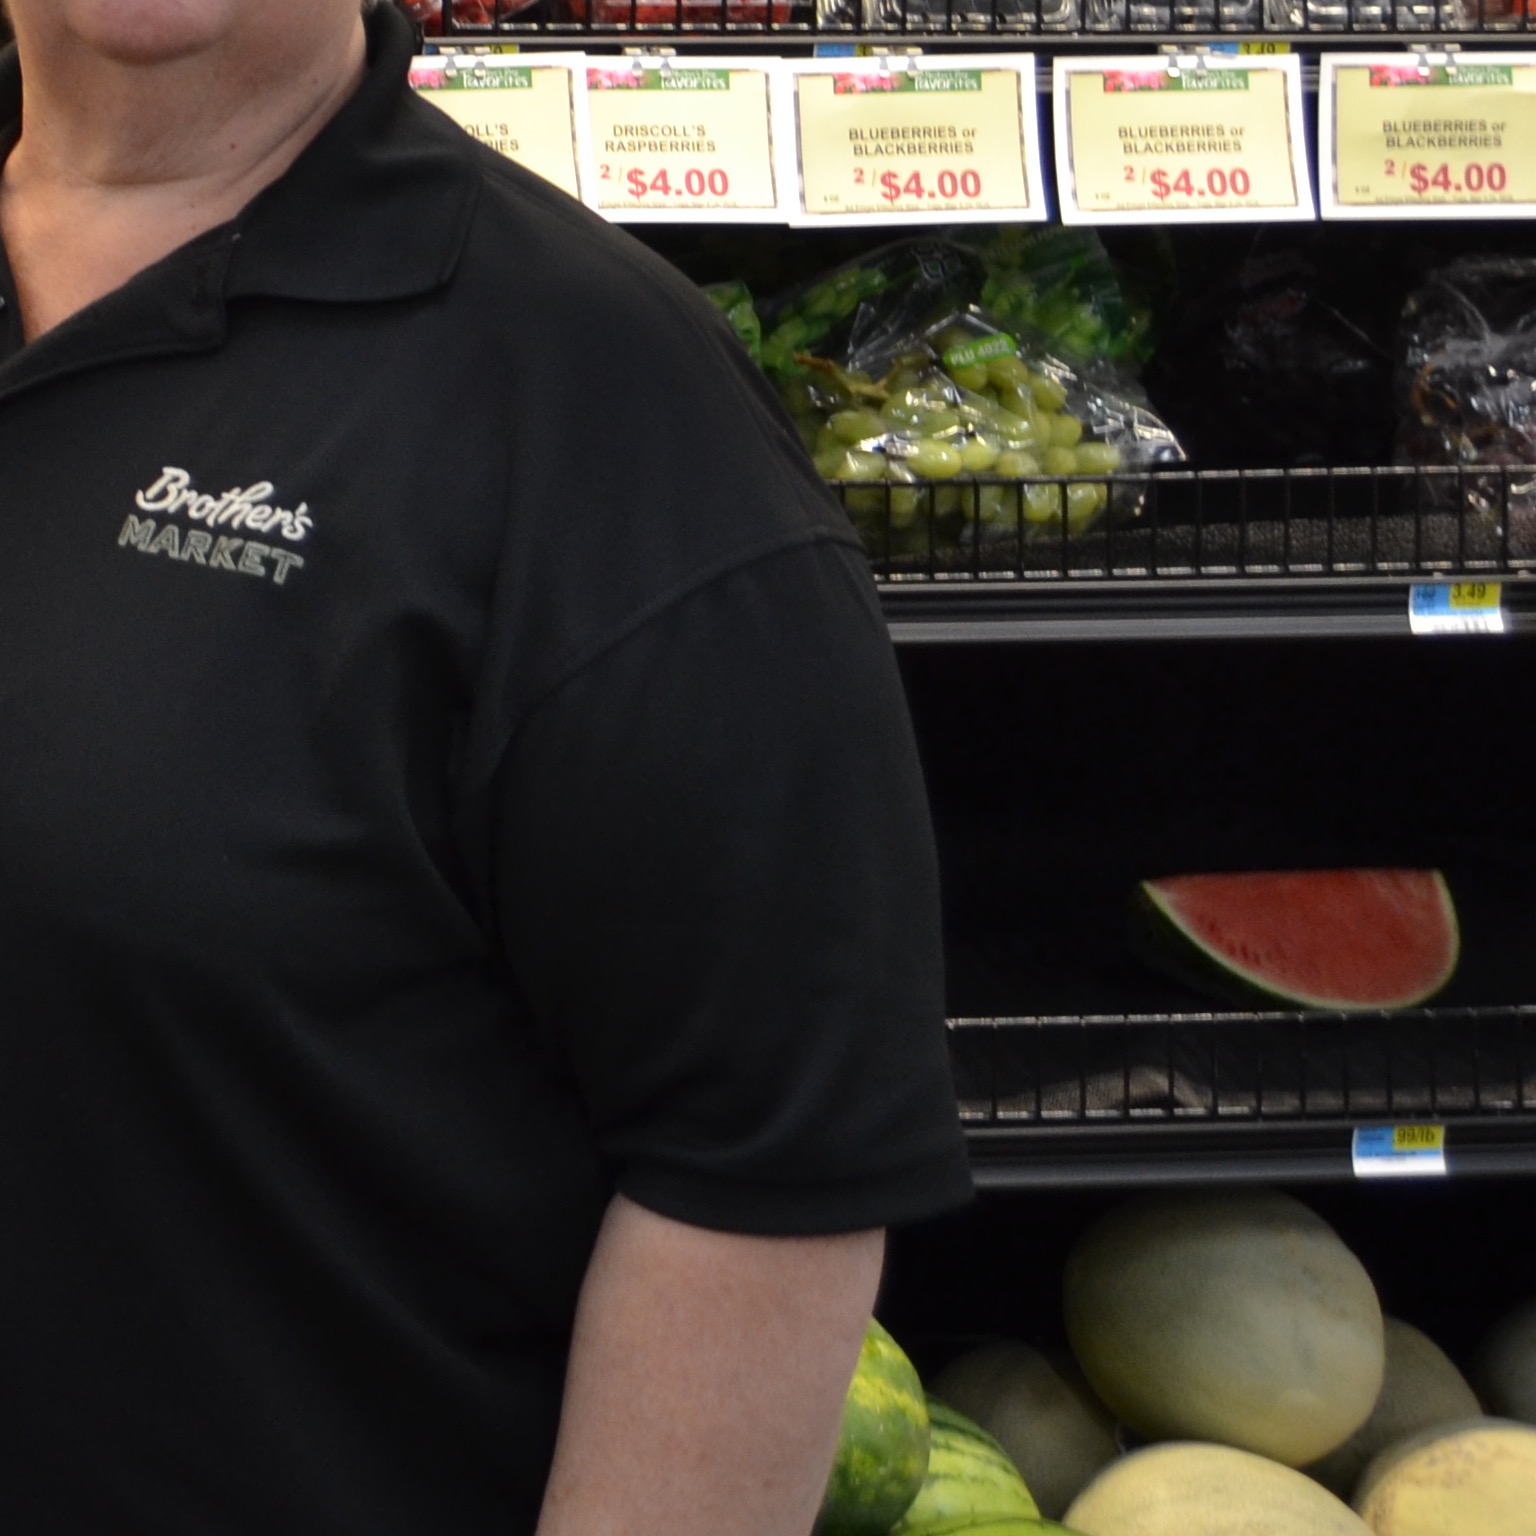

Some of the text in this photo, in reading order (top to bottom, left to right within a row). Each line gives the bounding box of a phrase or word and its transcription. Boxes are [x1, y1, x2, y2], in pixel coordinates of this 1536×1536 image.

[613, 124, 706, 137] DRISCOLL'S
[848, 126, 977, 141] BLUEBERRIES or
[1118, 124, 1245, 138] BLUEBERRIES or
[1382, 119, 1507, 134] BLUEBERRIES or
[604, 140, 716, 153] RASPBERRIES
[853, 141, 974, 156] BLACKBERRIES
[1123, 139, 1243, 154] BLACKBERRIES
[1385, 135, 1503, 149] BLACKBERRIES
[626, 167, 729, 201] $4.00
[880, 168, 982, 205] $4.00
[1149, 167, 1251, 201] $4.00
[1408, 162, 1507, 196] $4.00
[135, 466, 314, 542] Brother's
[117, 513, 305, 585] MARKET
